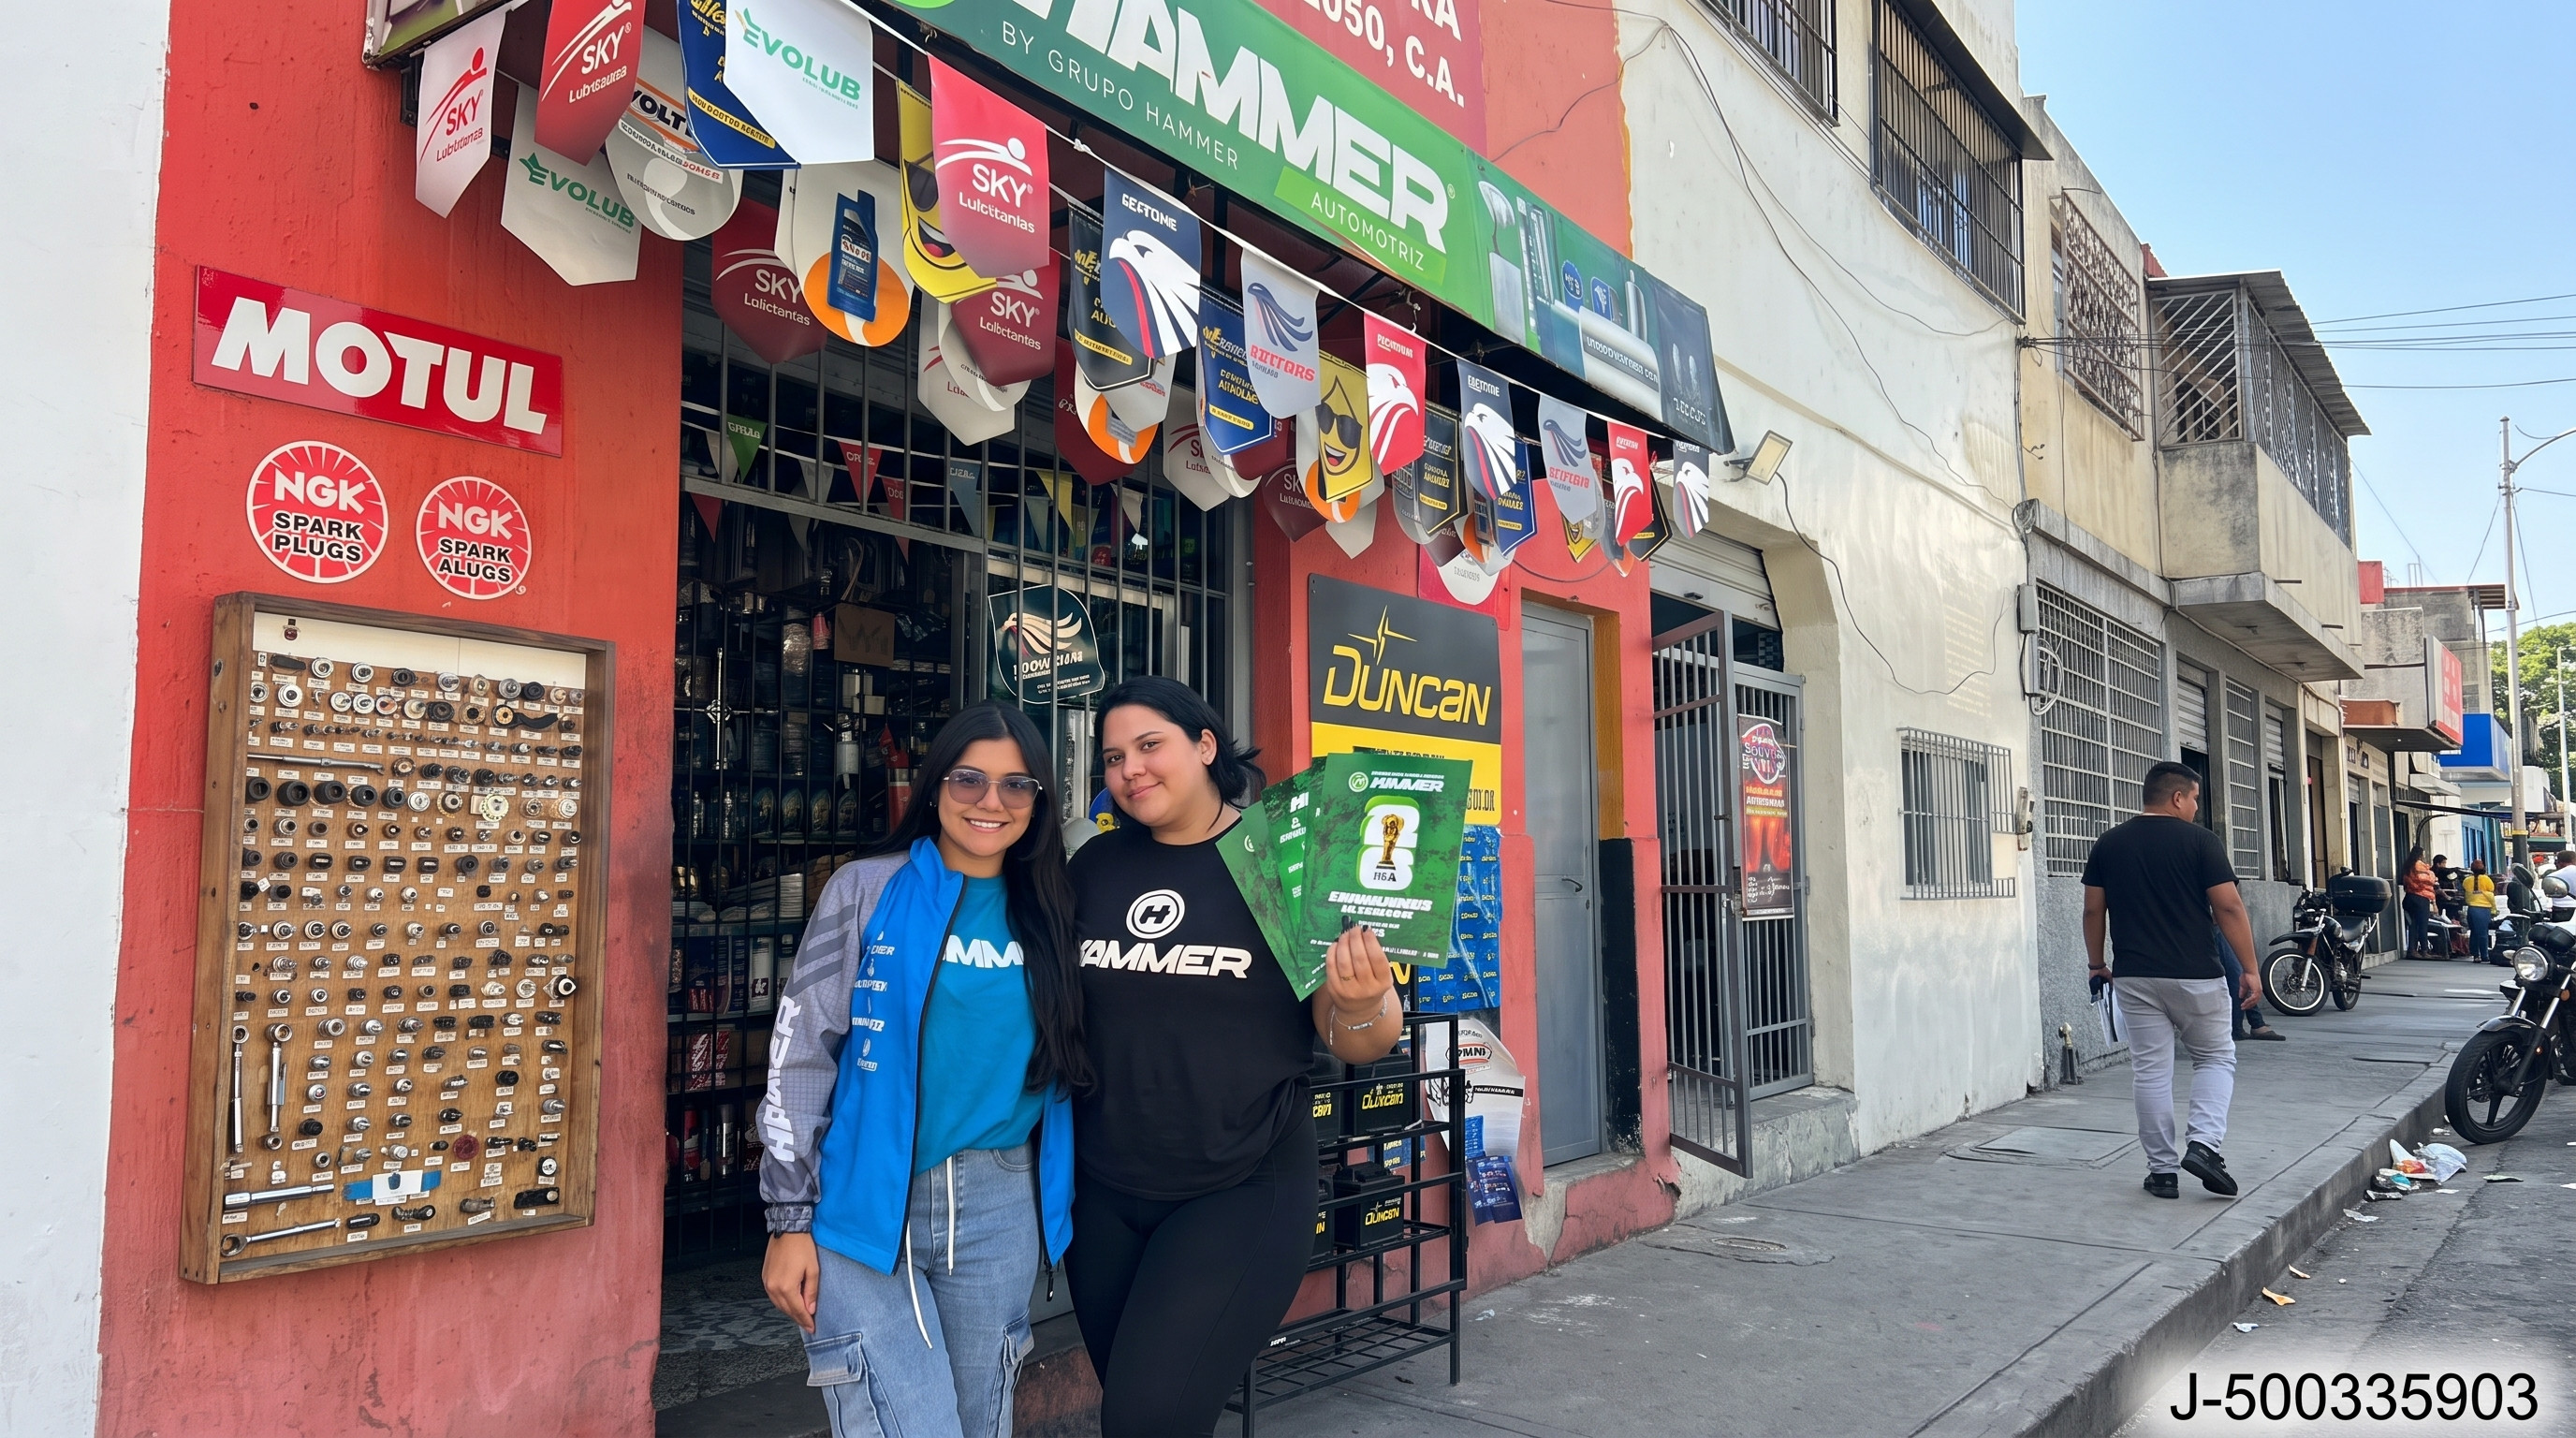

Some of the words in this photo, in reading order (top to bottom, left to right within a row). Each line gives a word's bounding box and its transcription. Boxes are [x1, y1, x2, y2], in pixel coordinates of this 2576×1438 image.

[580, 24, 625, 75] SKY
[741, 7, 861, 101] EVOLUB
[1405, 35, 1465, 109] C.A.
[446, 95, 481, 136] SKY
[632, 90, 694, 139] VOLT
[1002, 21, 1034, 54] BY
[1047, 49, 1134, 110] GRUPO
[1146, 101, 1237, 170] HAMMER
[520, 152, 636, 228] EVOLUB
[972, 163, 1026, 208] SKY
[1310, 191, 1425, 271] AUTOMOTRIZ
[754, 269, 801, 304] SKY
[990, 291, 1035, 328] SKY
[212, 296, 548, 434] MOTUL
[273, 467, 366, 515] NGK
[273, 511, 362, 541] SPARK
[437, 501, 514, 540] NGK
[273, 534, 362, 564] PLUGS
[439, 537, 511, 564] SPARK
[942, 934, 1024, 969] MM
[1079, 939, 1252, 979] AMMER
